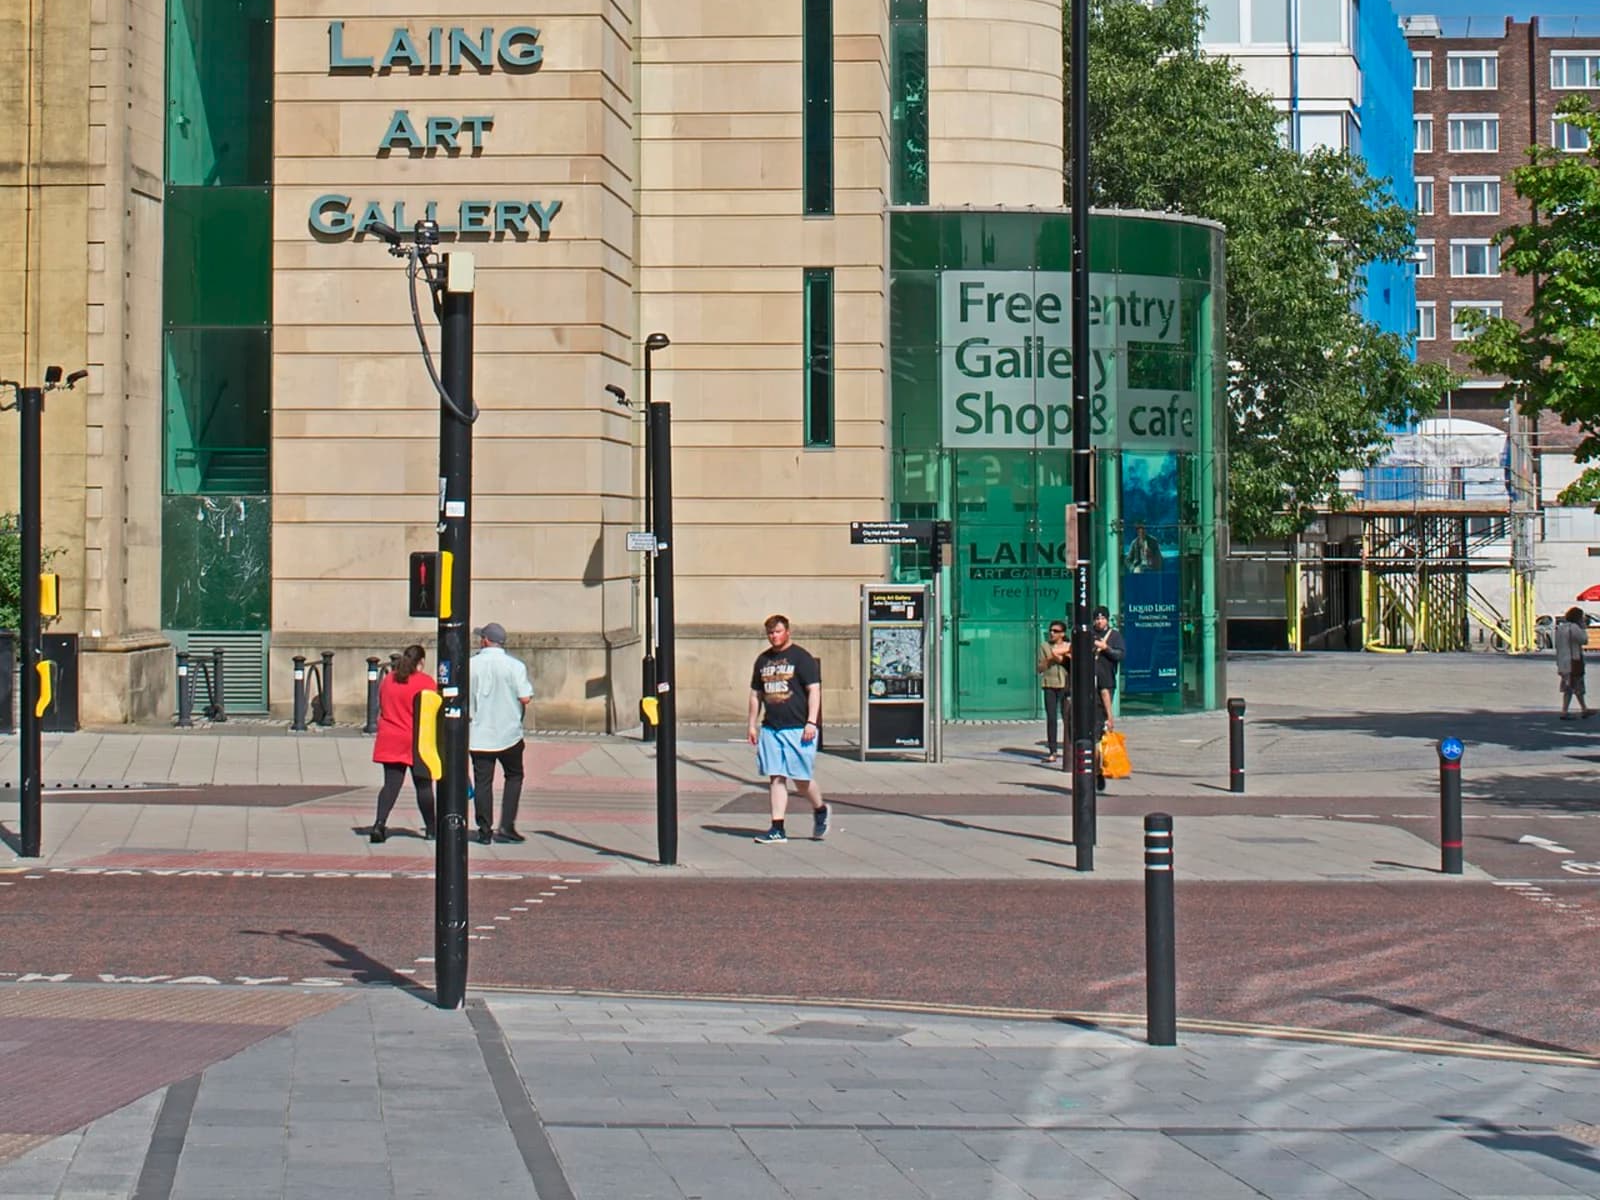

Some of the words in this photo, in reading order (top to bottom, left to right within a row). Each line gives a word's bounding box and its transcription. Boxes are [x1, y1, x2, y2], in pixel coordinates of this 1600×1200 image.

[328, 21, 544, 75] LAING
[377, 109, 494, 158] ART
[309, 194, 563, 243] GALLERY
[959, 281, 1062, 324] Free
[955, 335, 1108, 392] Galley
[955, 391, 1072, 446] Shop
[1128, 394, 1193, 438] cafe
[974, 568, 1004, 578] ART
[993, 585, 1021, 598] Free
[1128, 603, 1154, 614] LIQUID
